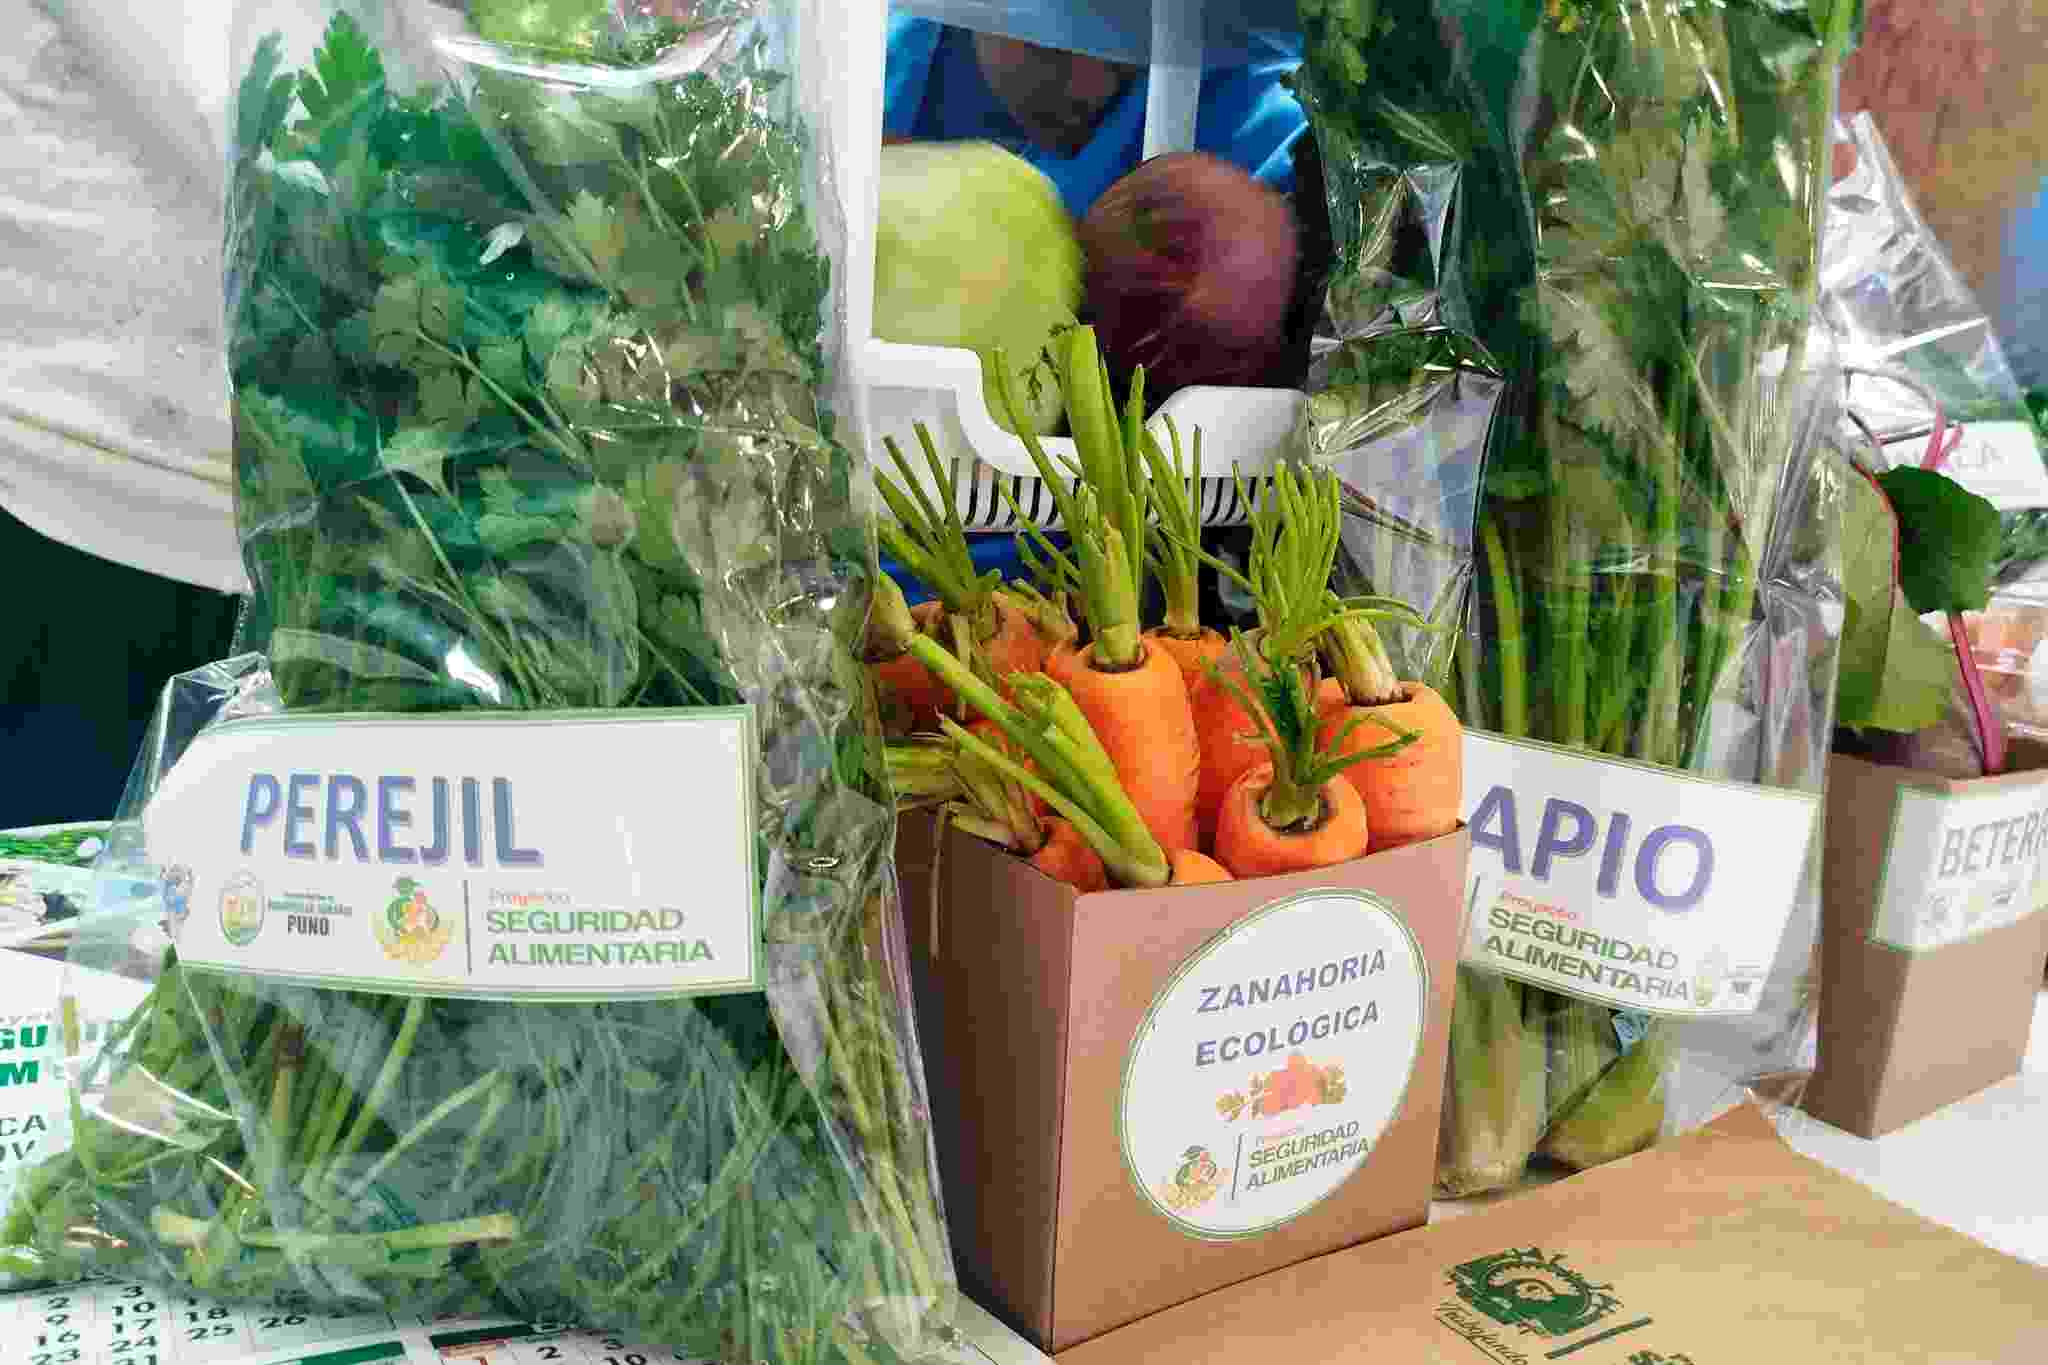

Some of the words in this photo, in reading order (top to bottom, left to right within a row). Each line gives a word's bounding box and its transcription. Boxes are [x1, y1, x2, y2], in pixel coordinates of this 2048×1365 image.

[240, 773, 543, 865] PEREJIL
[1469, 784, 1714, 911] APIO
[287, 915, 330, 937] PUNO
[487, 907, 684, 935] SEGURIDAD
[488, 938, 714, 966] ALIMENTARIA
[1487, 907, 1679, 970] SEGURIDAD
[1196, 949, 1386, 1014] ZANAHORIA
[1485, 934, 1689, 1001] ALIMENTARIA
[1249, 1121, 1360, 1168] SEGURIDAD
[1246, 1137, 1370, 1190] ALIMENTARIA
[48, 1296, 71, 1310] 2
[120, 1285, 144, 1298] 3
[112, 1301, 156, 1317] 10
[112, 1318, 157, 1335] 17
[184, 1307, 230, 1323] 18
[186, 1324, 236, 1341] 25
[258, 1314, 307, 1330] 26
[537, 1346, 563, 1361] 2
